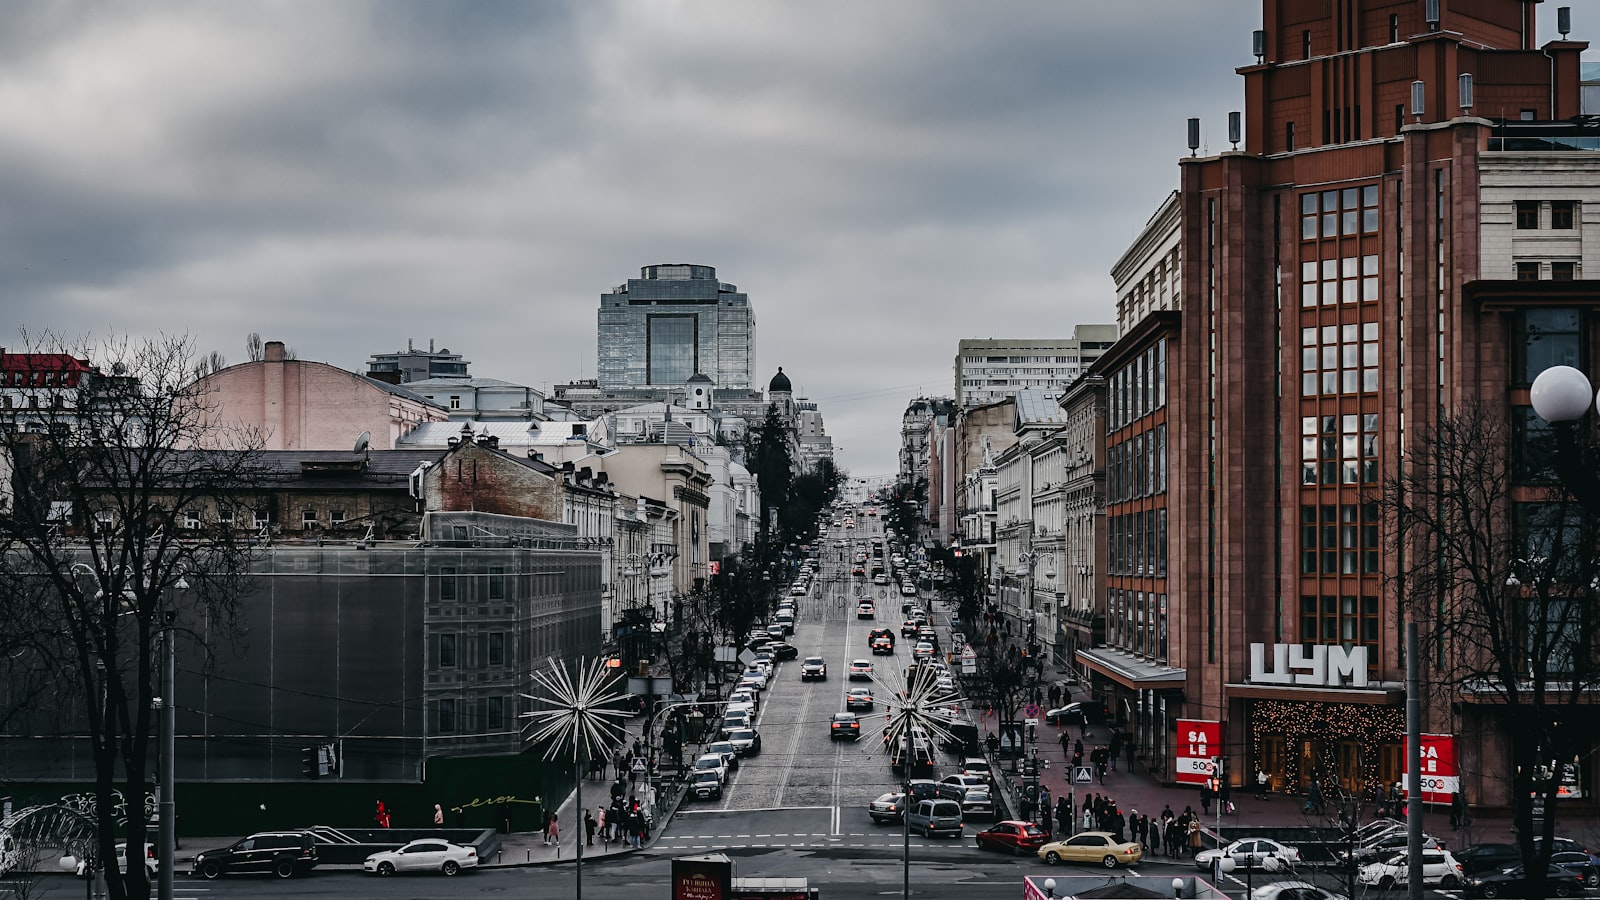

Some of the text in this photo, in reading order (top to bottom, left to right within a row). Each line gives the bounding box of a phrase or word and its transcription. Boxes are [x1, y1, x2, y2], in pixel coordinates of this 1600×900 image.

[1250, 642, 1368, 687] ЦУМ
[1188, 731, 1207, 743] SA
[1189, 744, 1206, 755] LE
